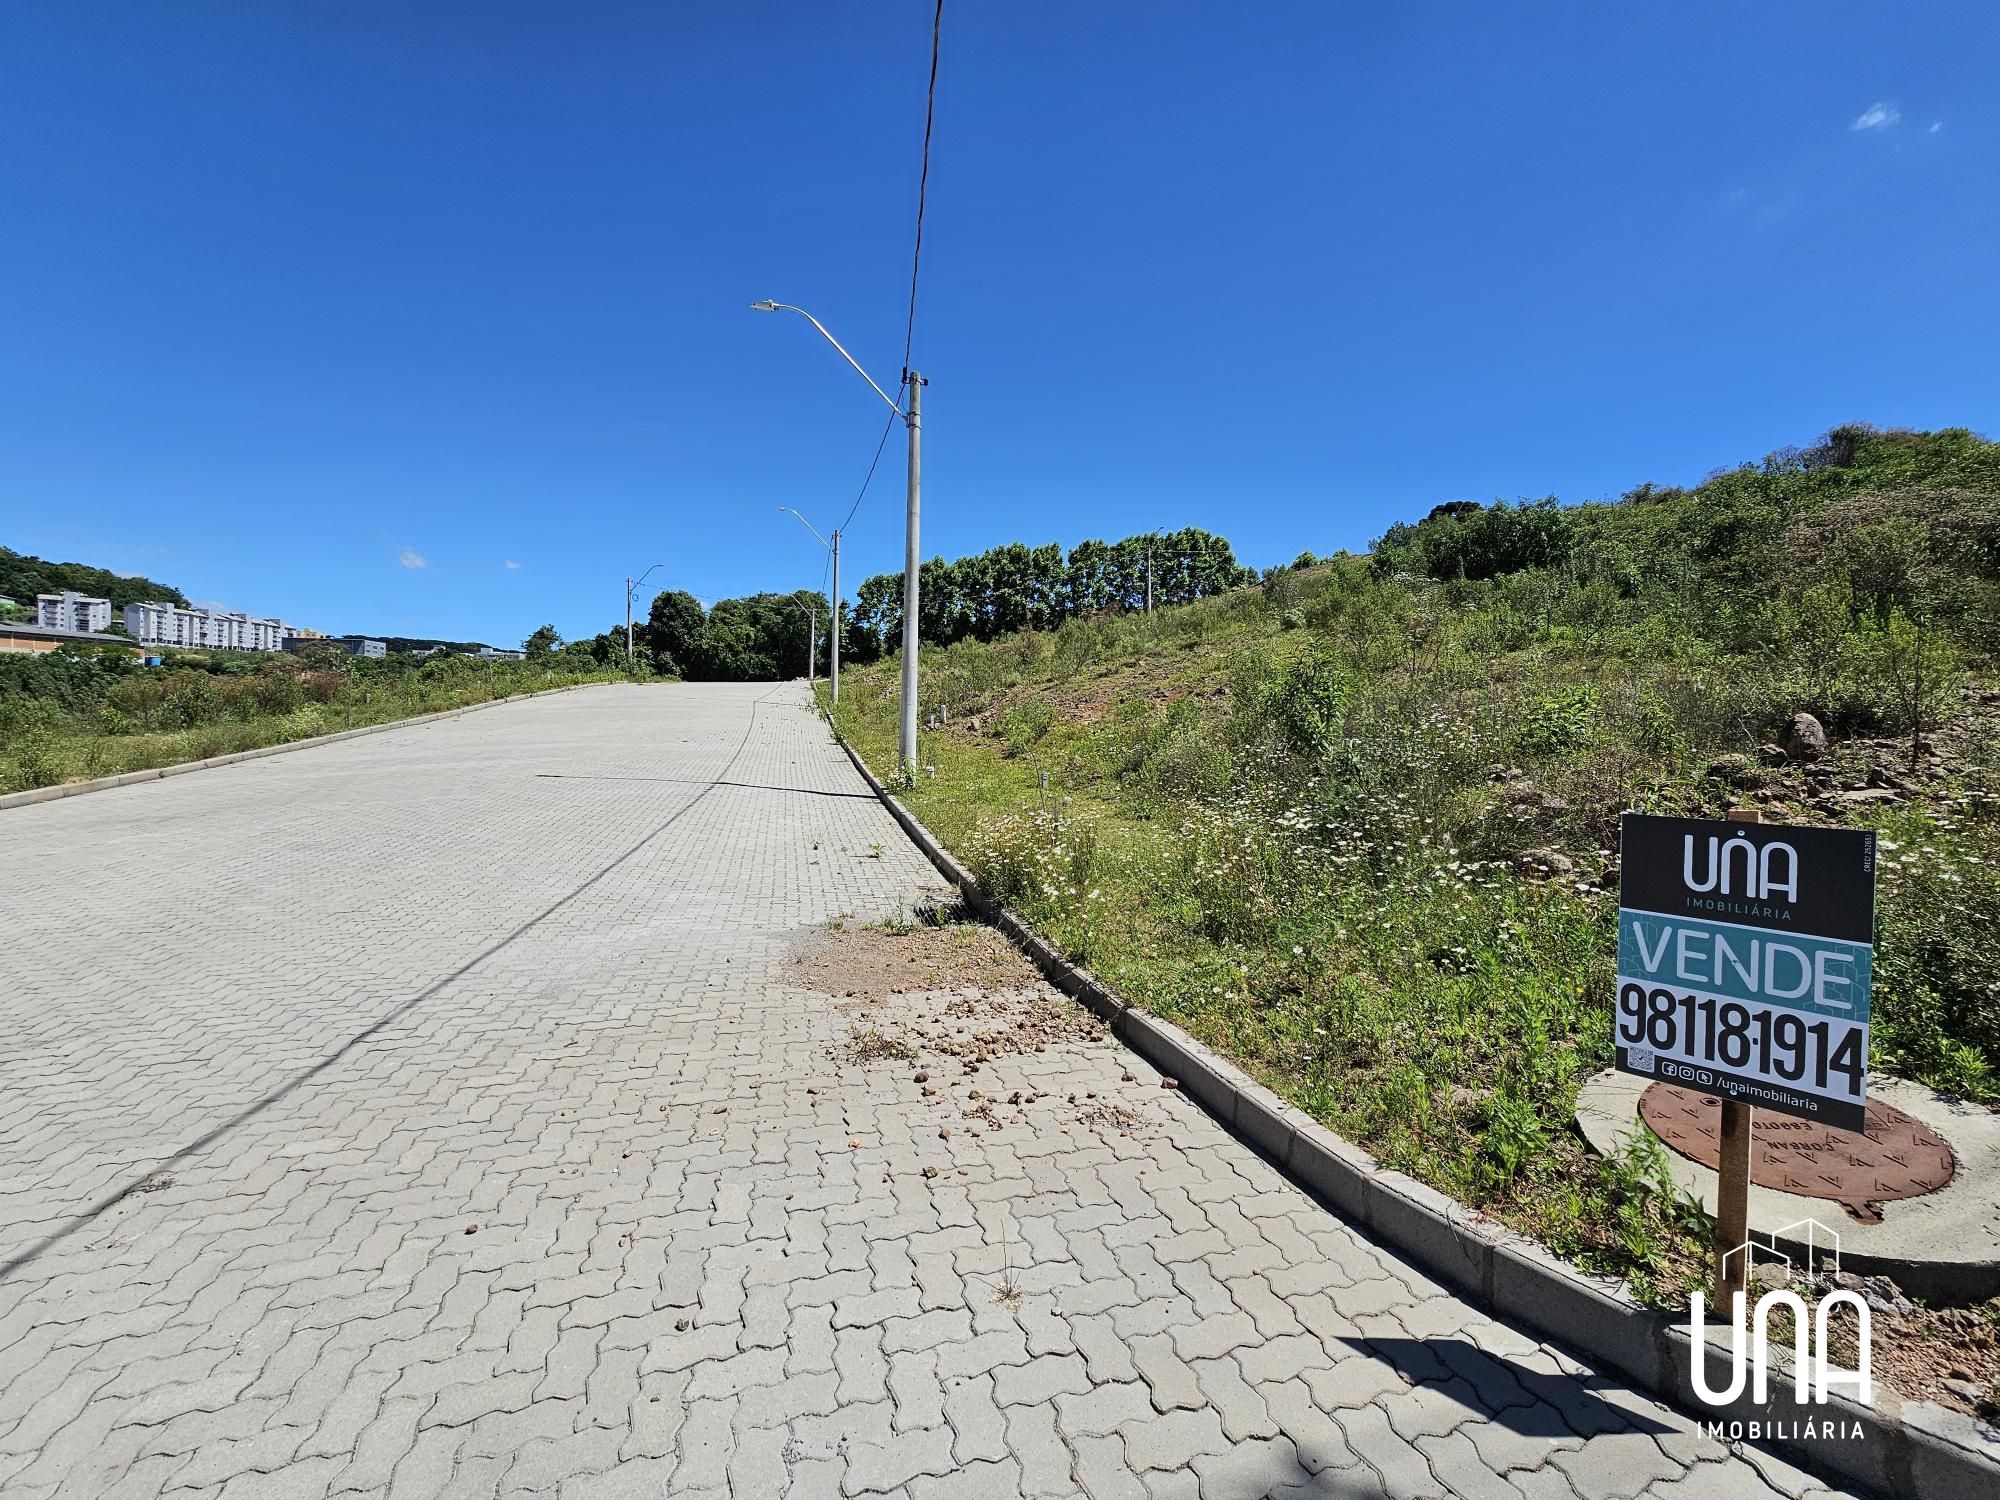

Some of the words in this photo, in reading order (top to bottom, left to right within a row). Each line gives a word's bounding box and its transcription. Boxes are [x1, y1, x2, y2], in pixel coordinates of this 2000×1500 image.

[1683, 834, 1799, 904] UNA
[1863, 855, 1871, 873] CRECI
[1686, 896, 1792, 921] IMOBILIÁRIA
[1632, 921, 1855, 1010] VENDE
